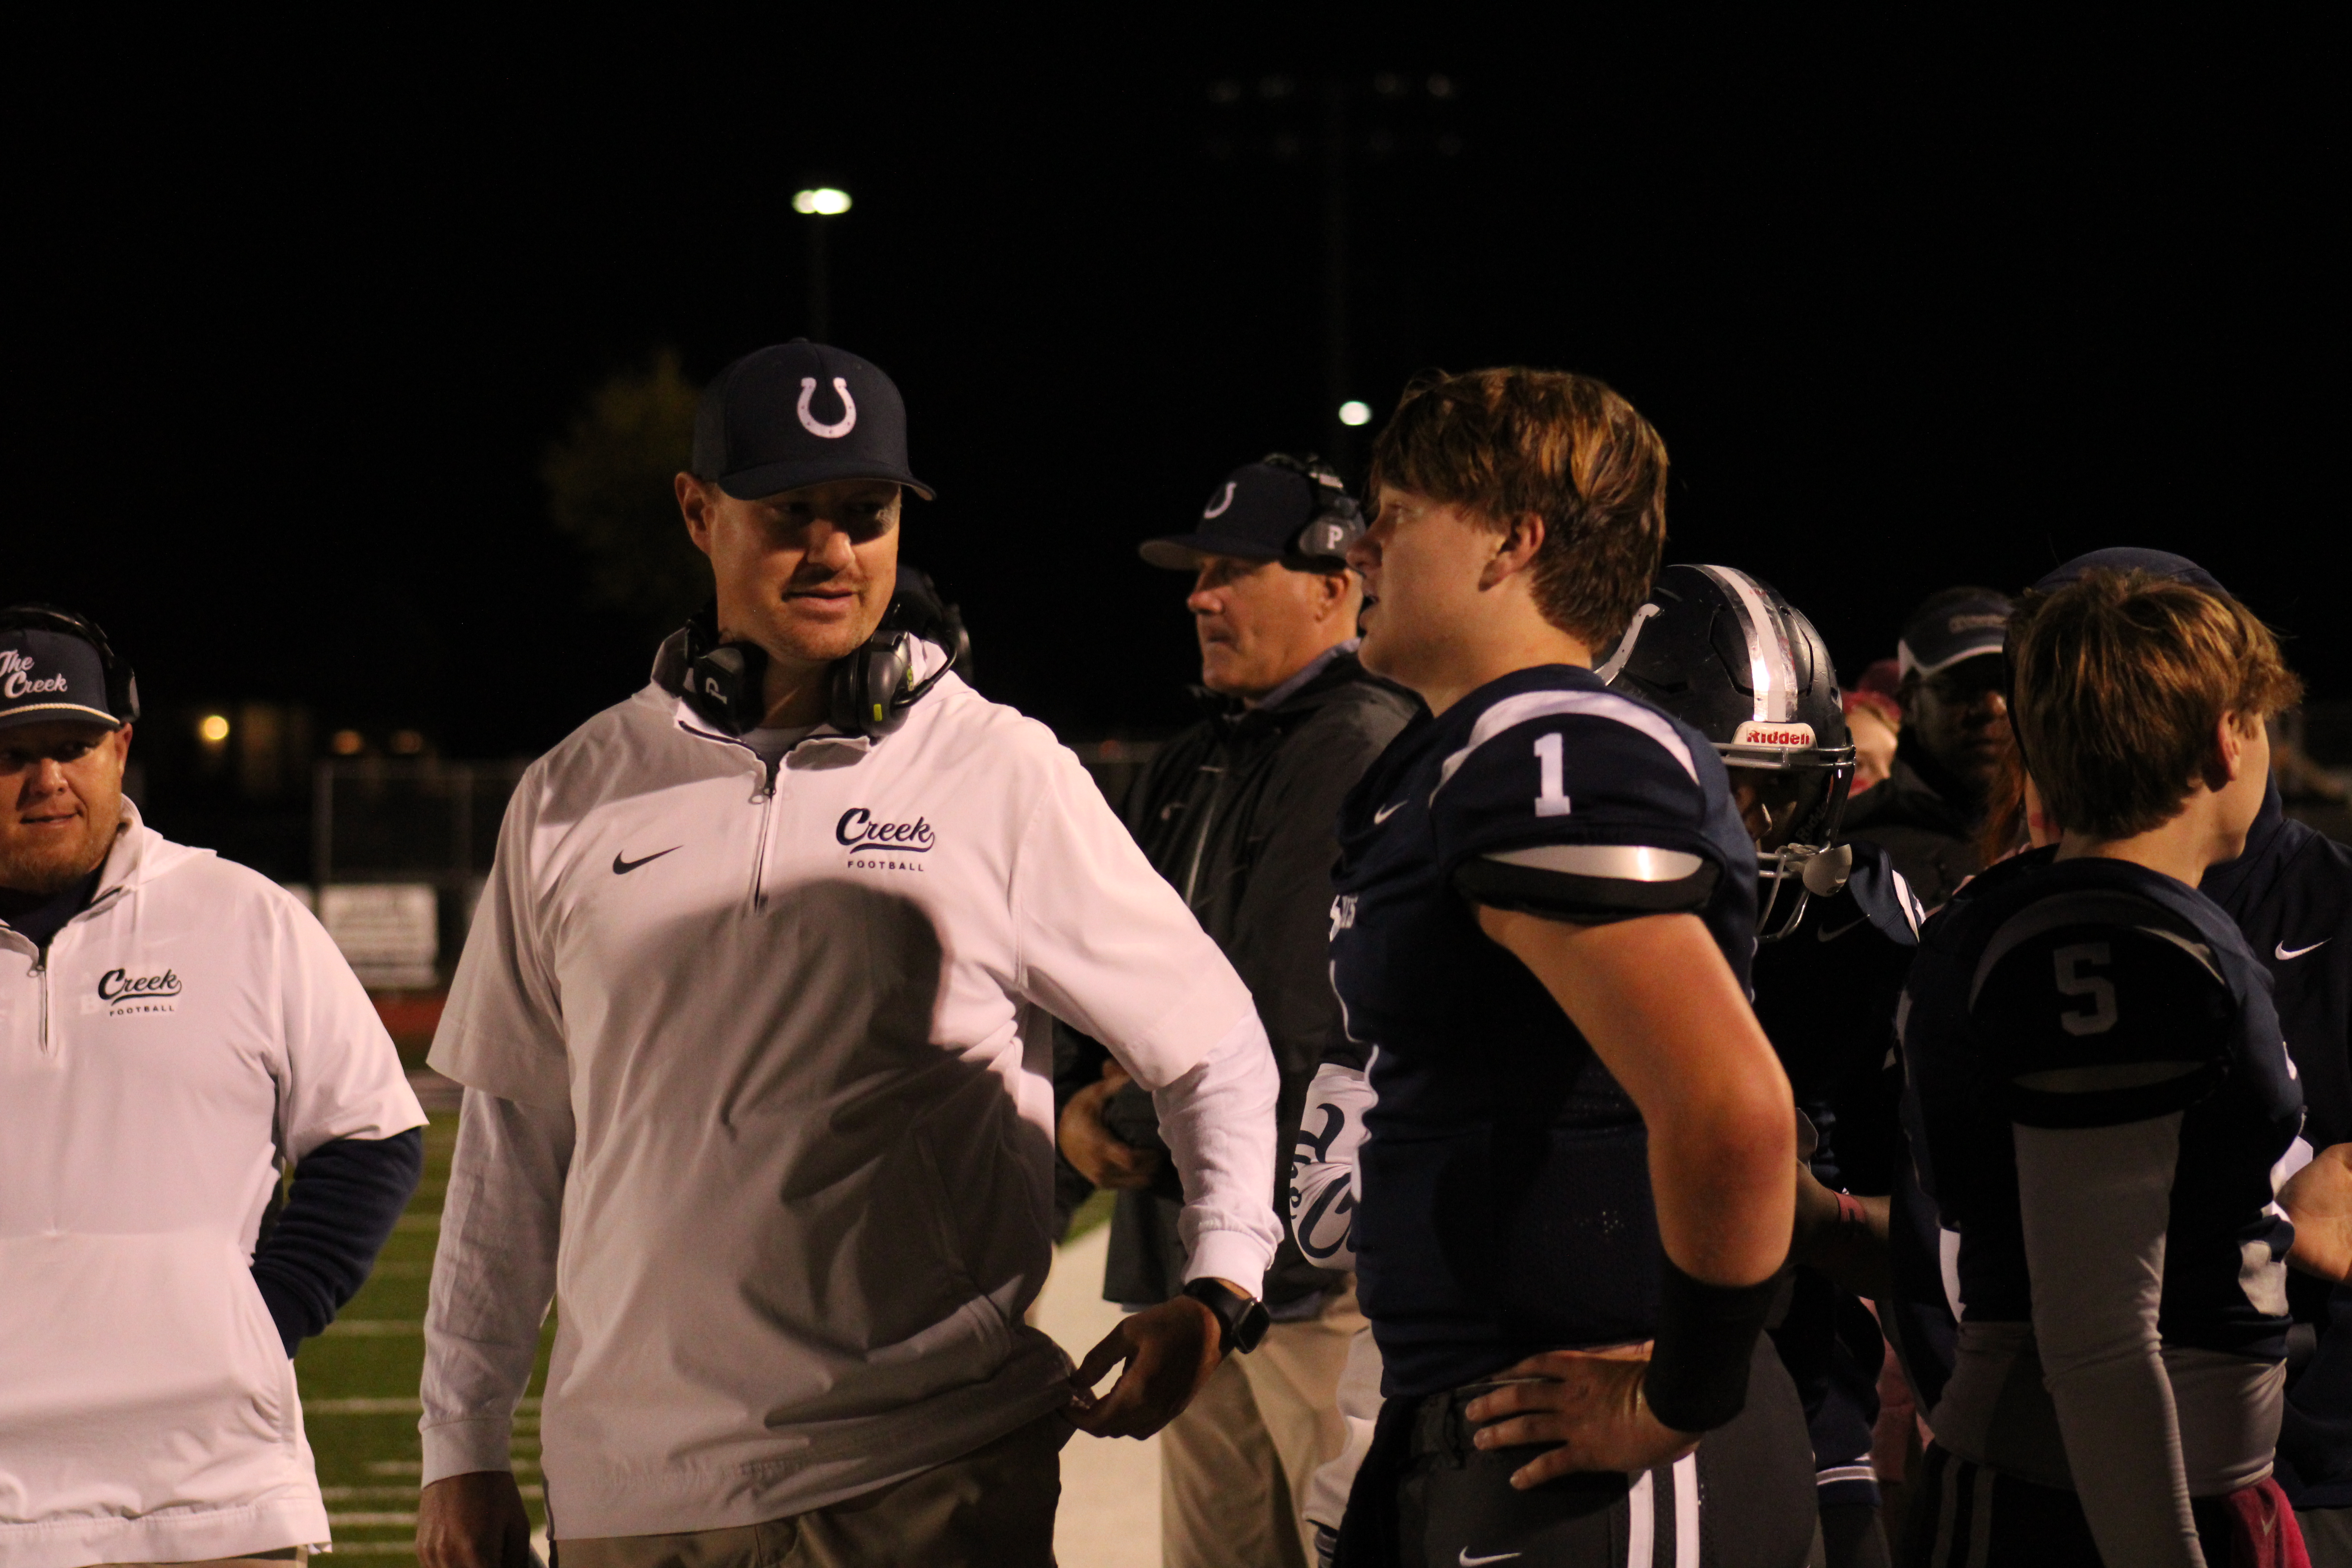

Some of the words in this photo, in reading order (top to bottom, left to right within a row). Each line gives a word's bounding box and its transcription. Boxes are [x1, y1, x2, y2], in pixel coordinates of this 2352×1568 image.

[1327, 524, 1343, 549] P
[0, 649, 35, 678] The
[4, 670, 68, 699] Creek
[706, 677, 728, 705] P
[1534, 732, 1571, 818] 1
[836, 808, 935, 853] Creek
[848, 860, 924, 871] FOOTBALL
[98, 968, 182, 1006] Creek
[2053, 942, 2118, 1036] 5
[109, 1005, 175, 1017] FOOTBALL
